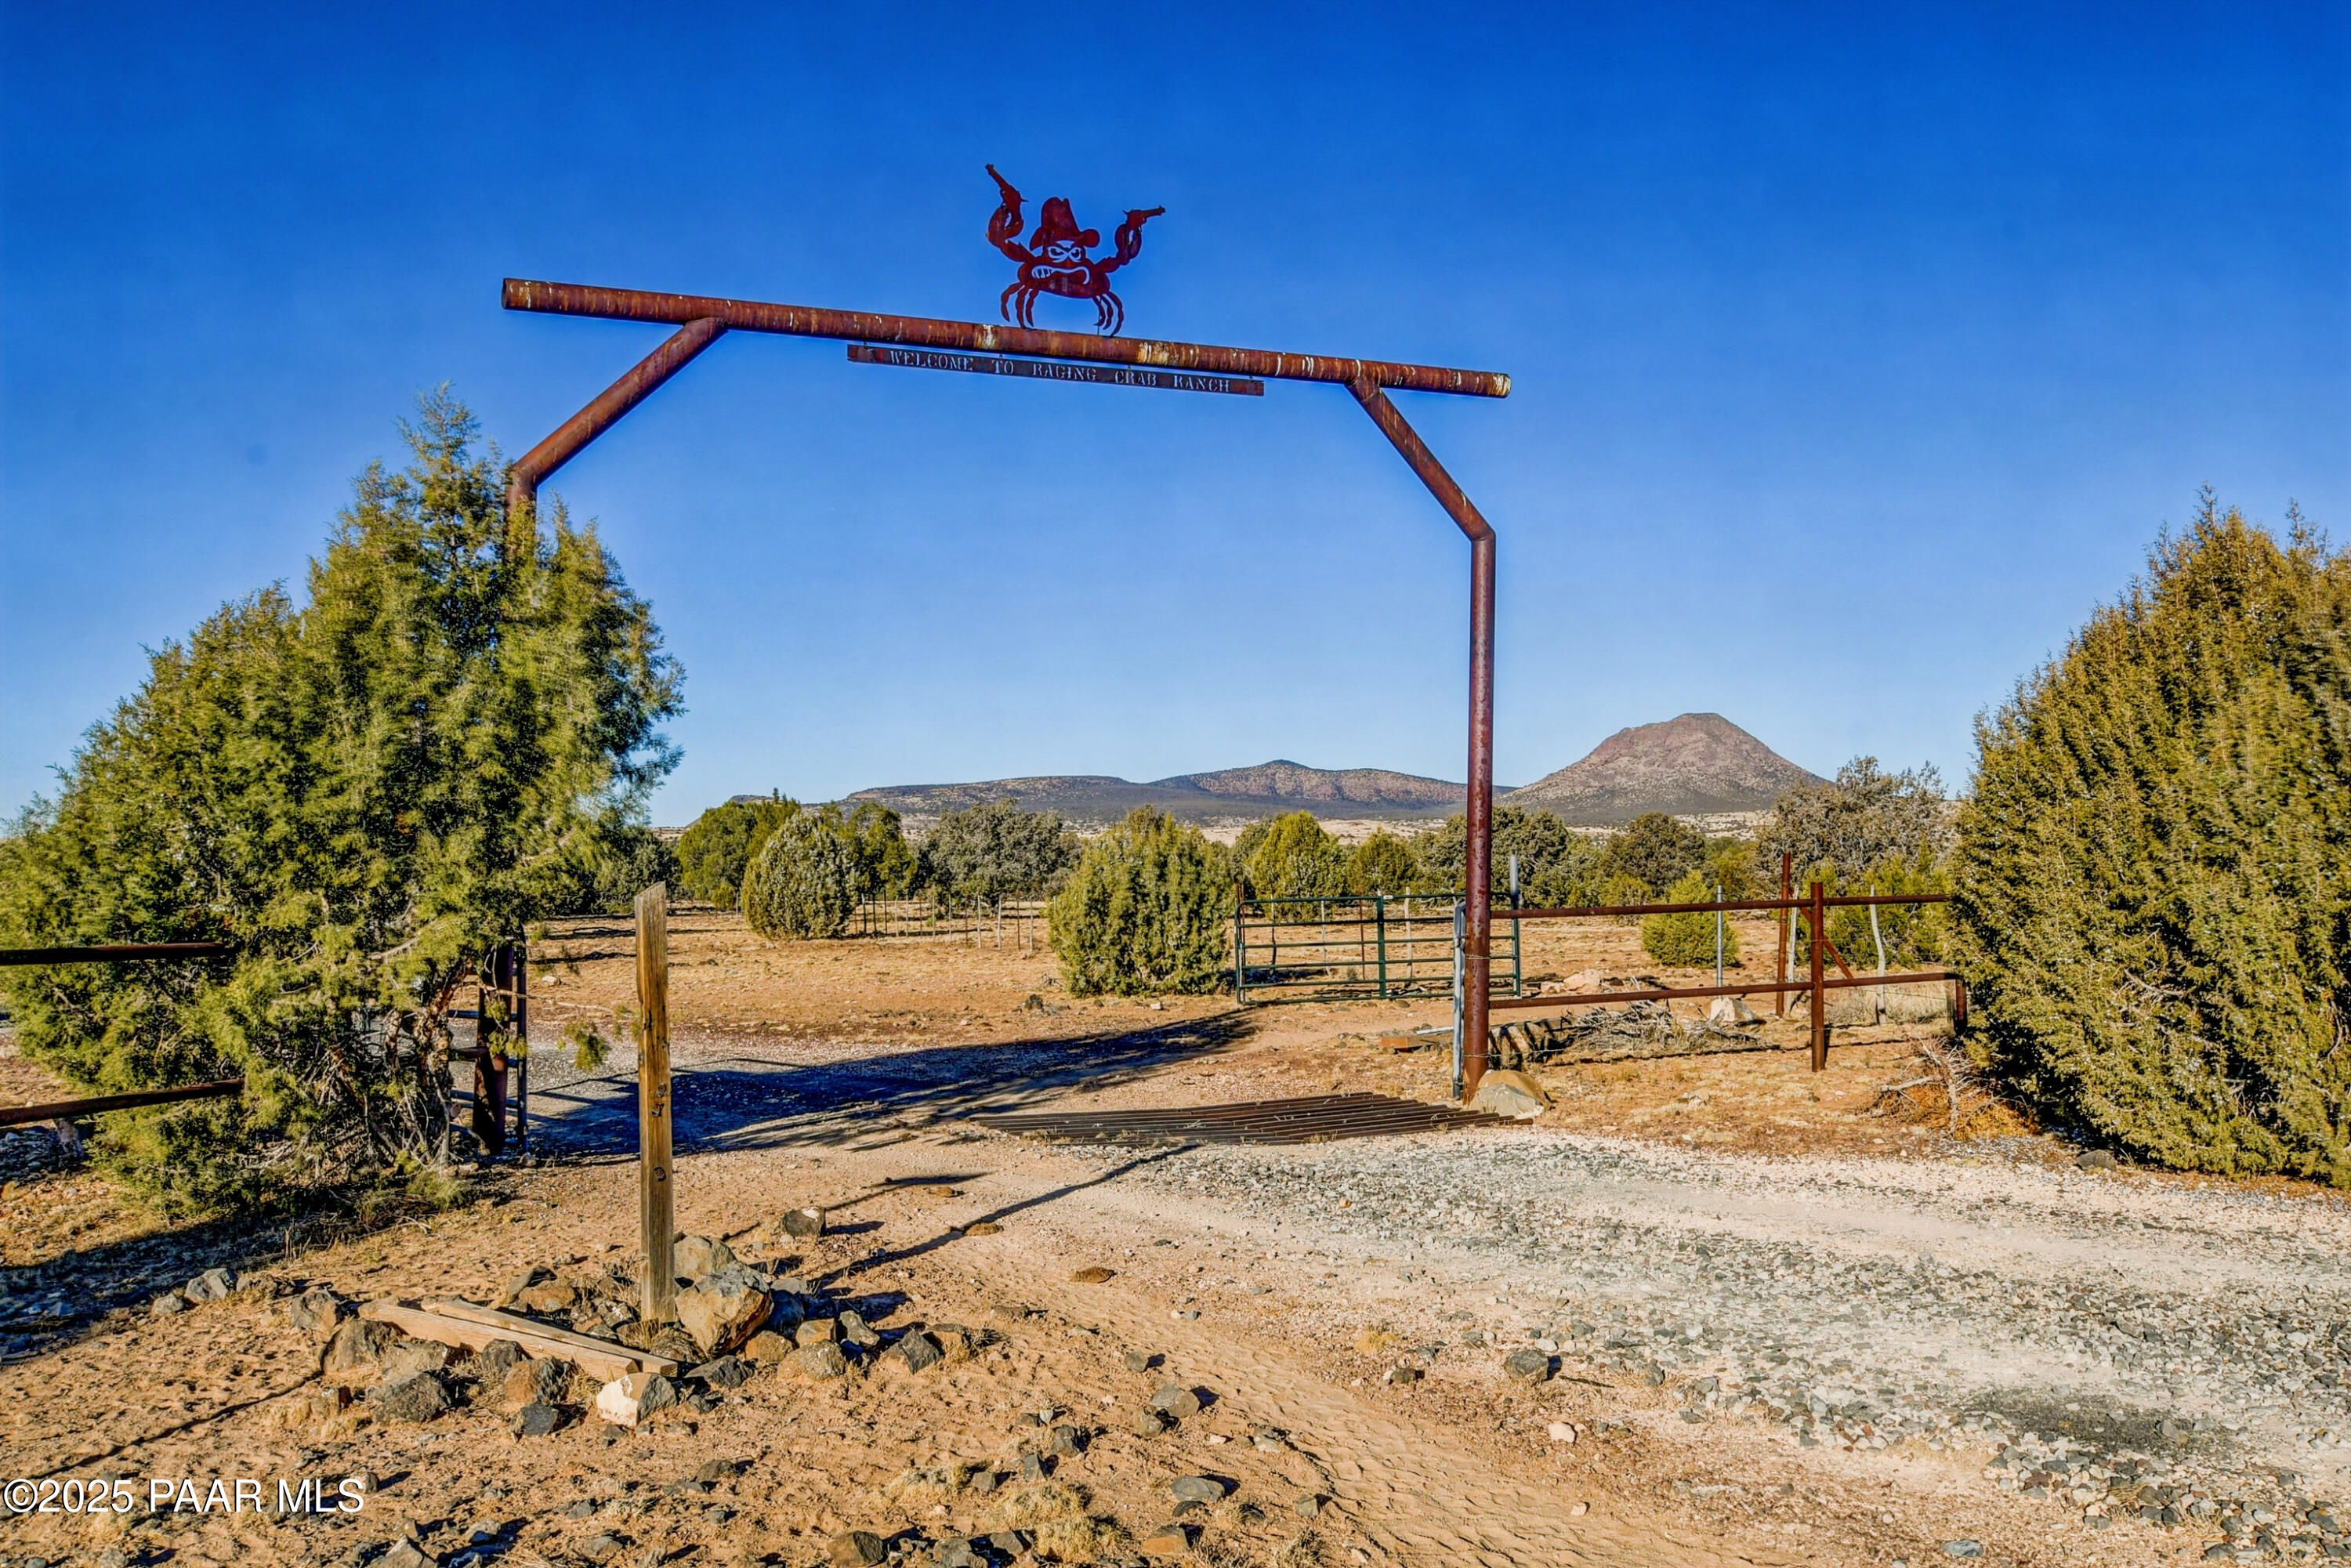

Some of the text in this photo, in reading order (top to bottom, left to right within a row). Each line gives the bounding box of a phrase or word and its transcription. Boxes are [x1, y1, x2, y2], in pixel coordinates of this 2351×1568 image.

[889, 350, 1230, 393] WELCOME TO RAGING CRAB RANCH
